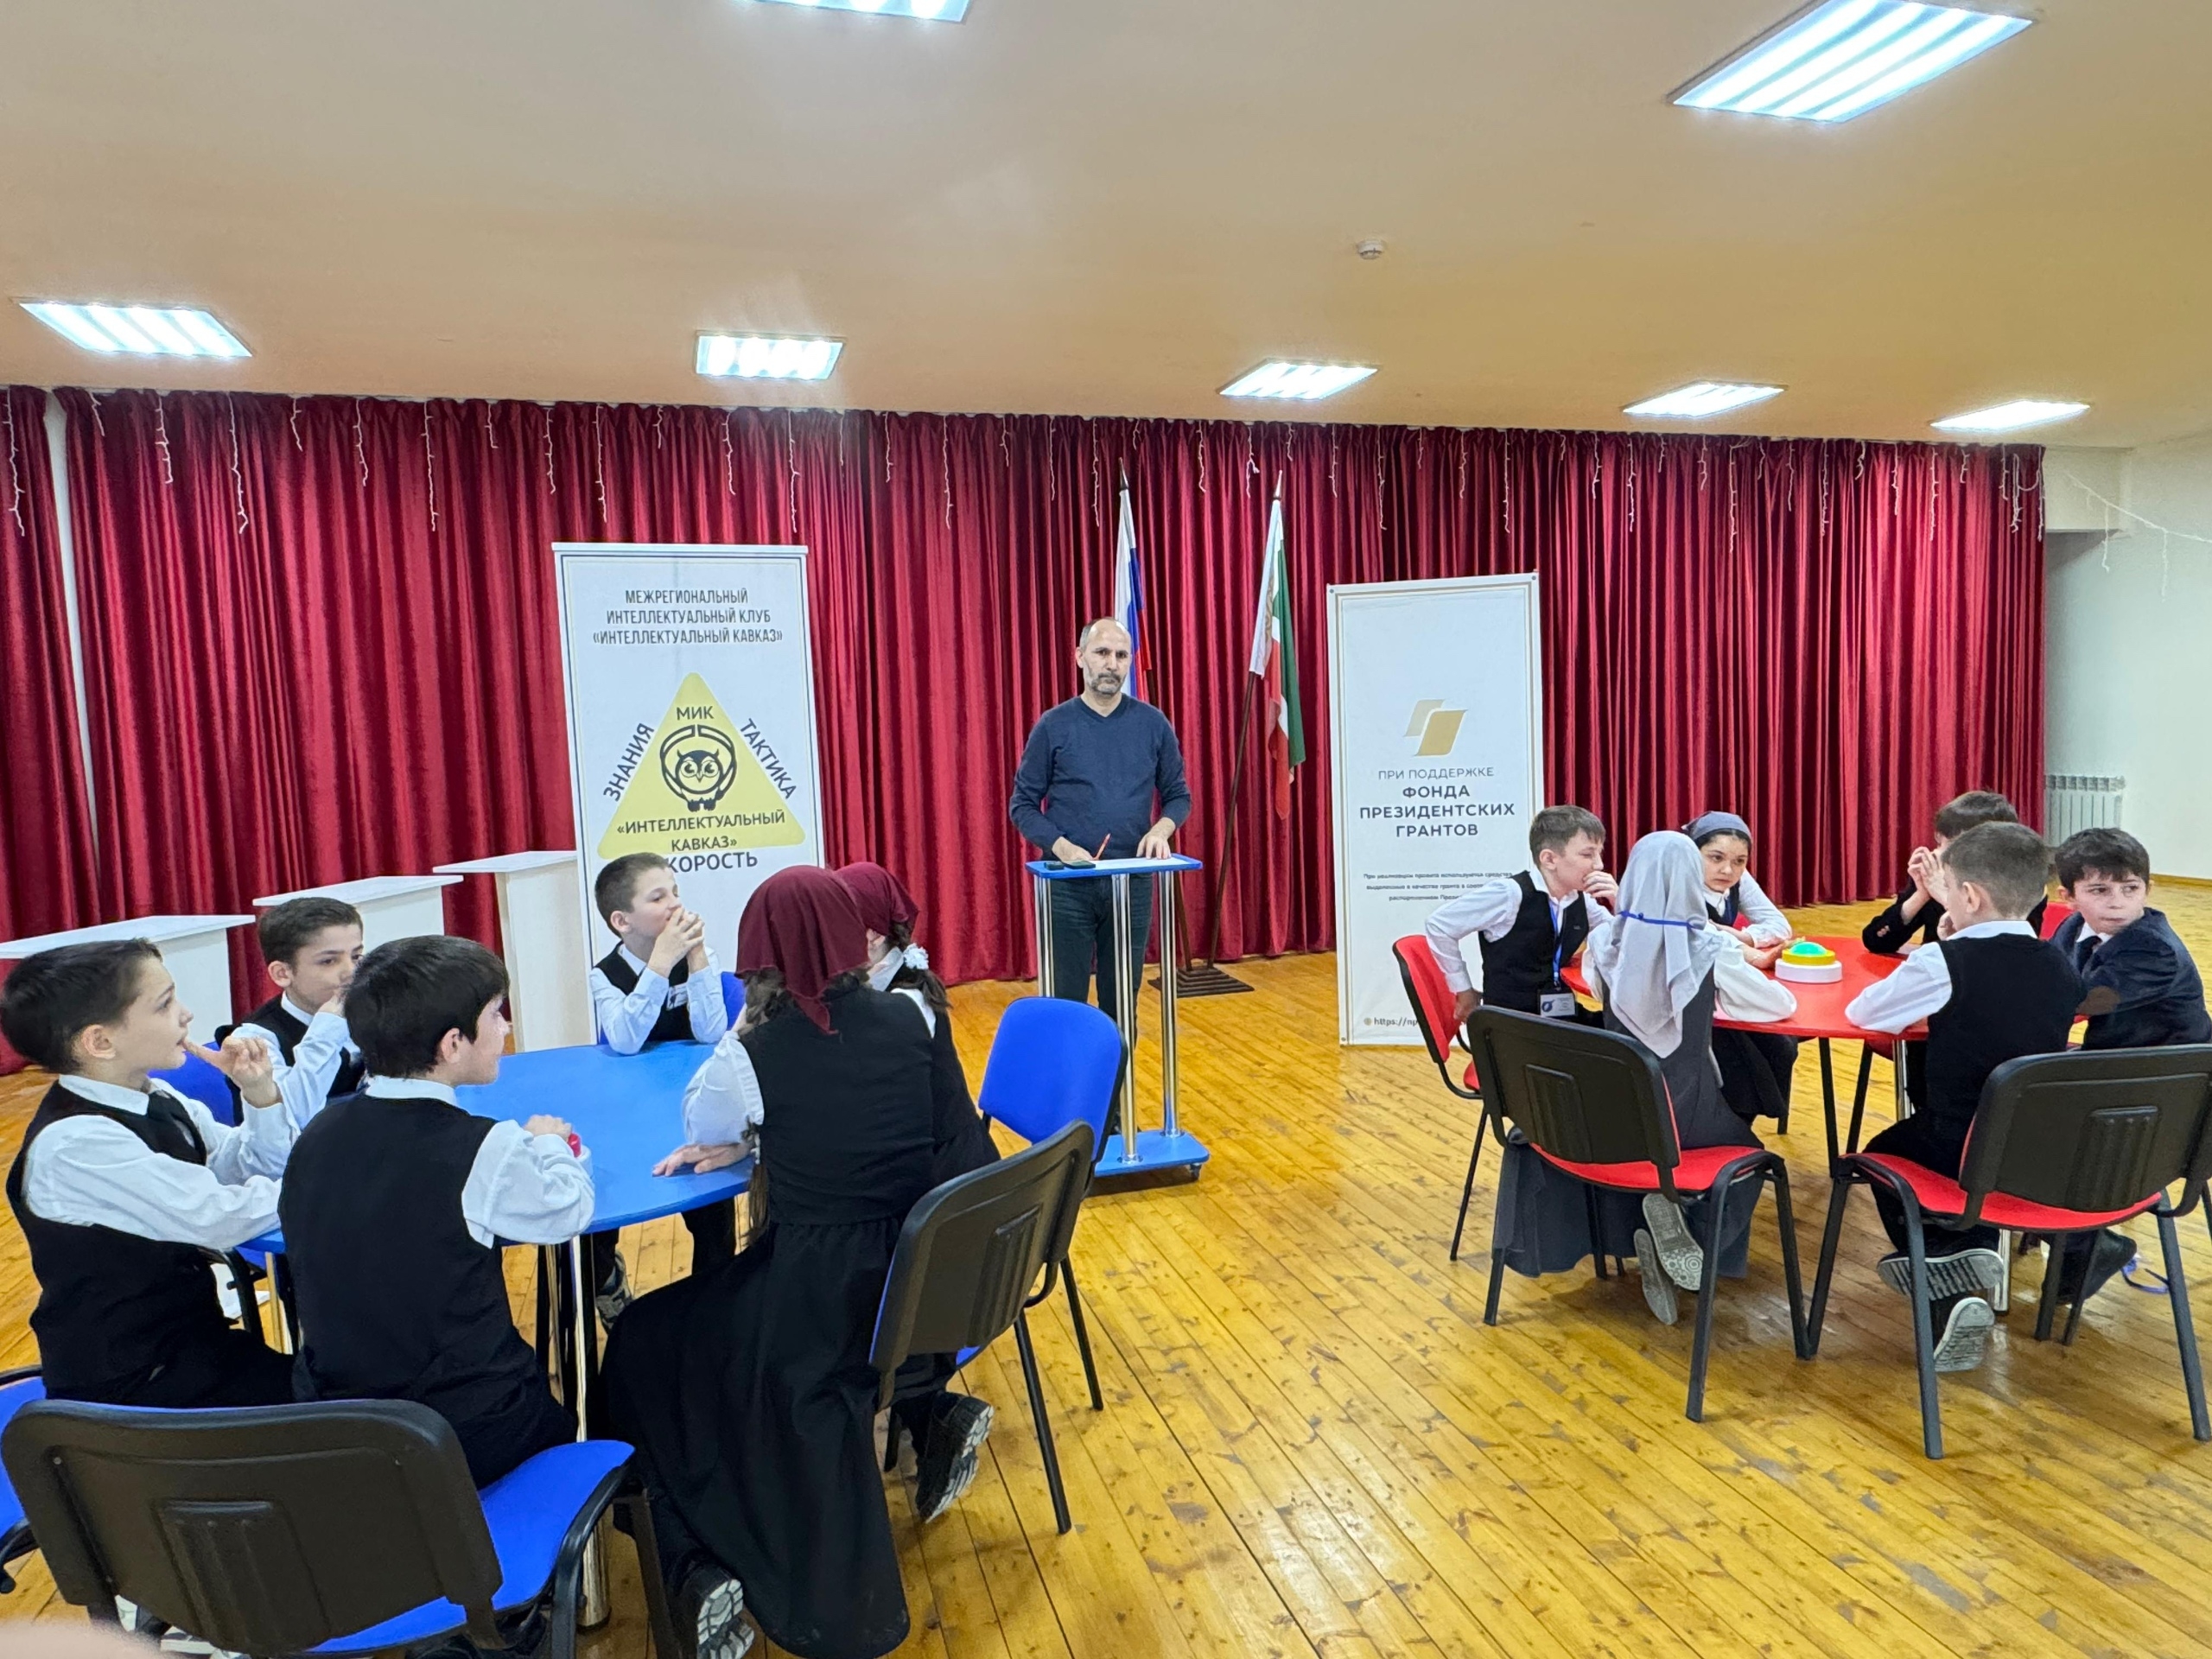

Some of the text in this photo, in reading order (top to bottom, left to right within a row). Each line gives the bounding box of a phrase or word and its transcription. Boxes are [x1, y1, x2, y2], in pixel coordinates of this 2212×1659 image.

[625, 588, 748, 604] МЕЖРЕГИОНАЛЬНЫЙ
[607, 607, 771, 625] ИНТЕЛЛЕКТУАЛЬНЫЙ КЛУБ
[593, 627, 783, 645] «ИНТЕЛЛЕКТУАЛЬНЫЙ КАВКАЗ»
[676, 705, 715, 721] МИК
[603, 722, 655, 802] ЗНАНИЯ
[740, 718, 797, 799] ТАКТИКА
[1378, 766, 1495, 780] ПРИ ПОДДЕРЖКЕ
[1402, 785, 1471, 799] ФОНДА
[1359, 803, 1516, 820] ПРЕЗИДЕНТСКИХ
[617, 809, 785, 835] «ИНТЕЛЛЕКТУАЛЬНЫЙ
[1395, 823, 1478, 838] ГРАНТОВ
[671, 835, 738, 853] КАВКАЗ»
[665, 851, 758, 874] КОРОСТЬ
